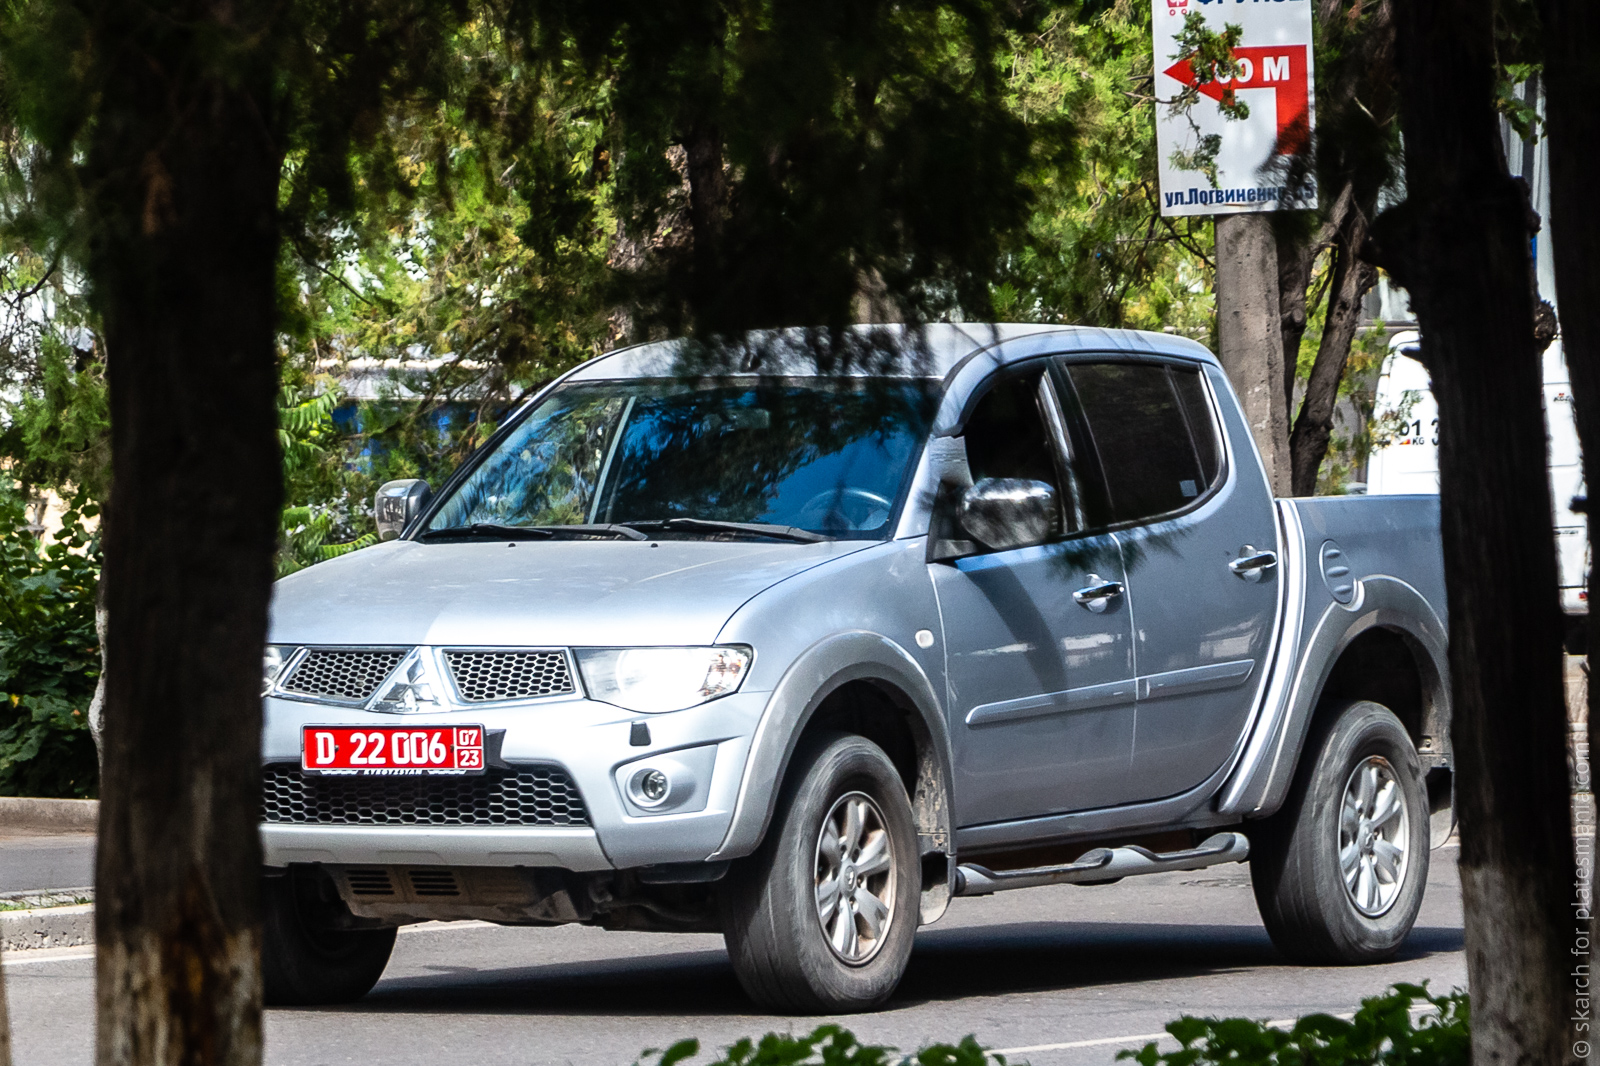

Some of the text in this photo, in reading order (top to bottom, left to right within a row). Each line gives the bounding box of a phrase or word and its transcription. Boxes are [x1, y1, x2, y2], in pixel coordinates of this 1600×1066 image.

[1263, 56, 1290, 82] М
[315, 732, 447, 765] D 22 006
[459, 729, 478, 746] 07
[460, 749, 479, 767] 23
